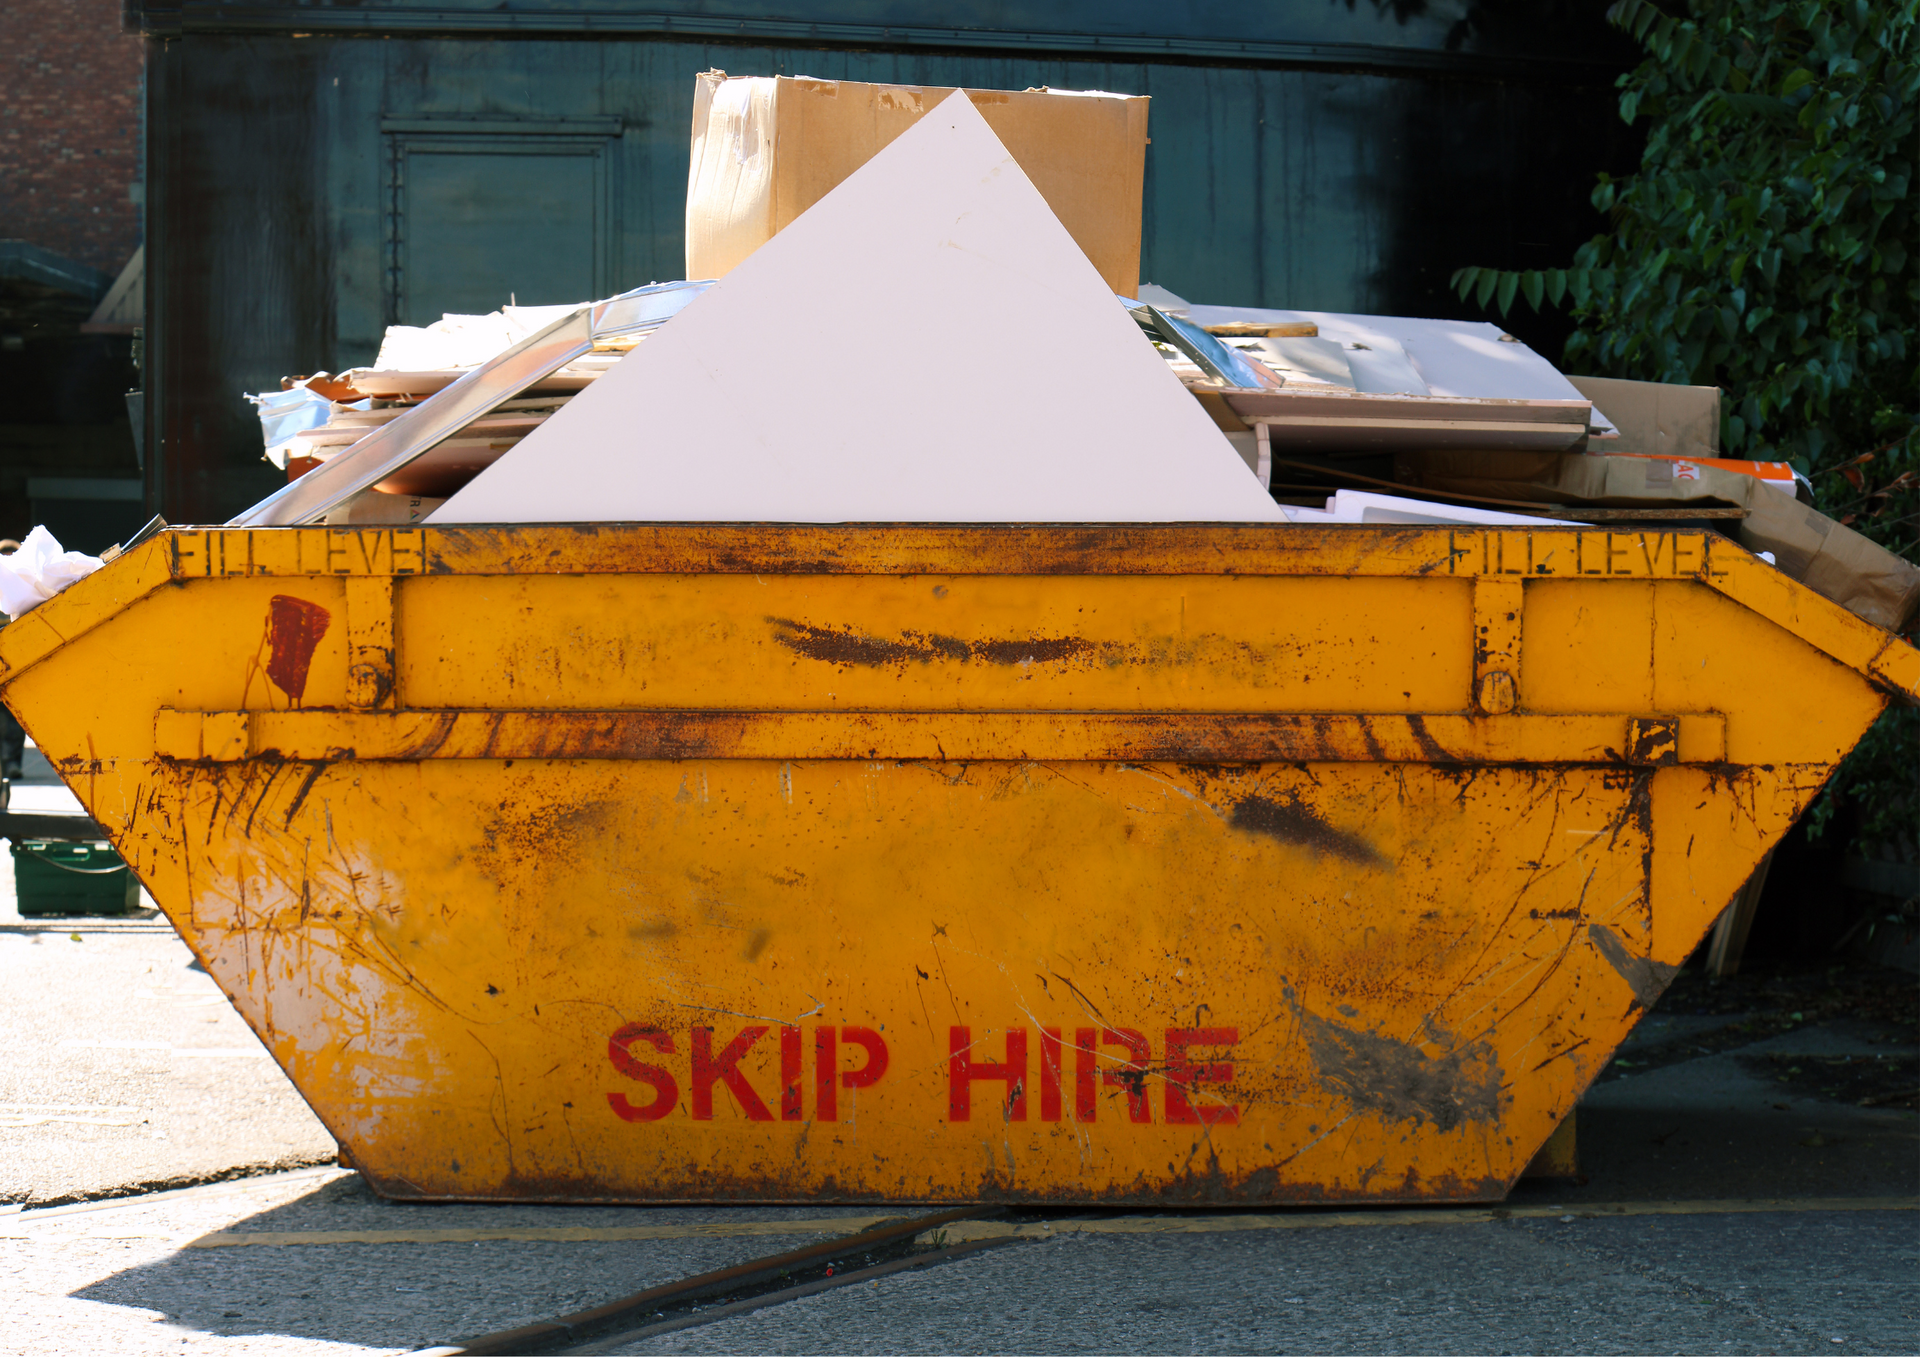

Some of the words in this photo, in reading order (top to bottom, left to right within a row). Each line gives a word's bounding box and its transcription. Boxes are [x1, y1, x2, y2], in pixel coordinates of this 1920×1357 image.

[171, 530, 273, 576] FILL
[1449, 529, 1552, 575] FILL
[1576, 531, 1729, 576] LEVEL
[606, 1021, 889, 1123] SKIP
[949, 1025, 1240, 1125] HIRE
